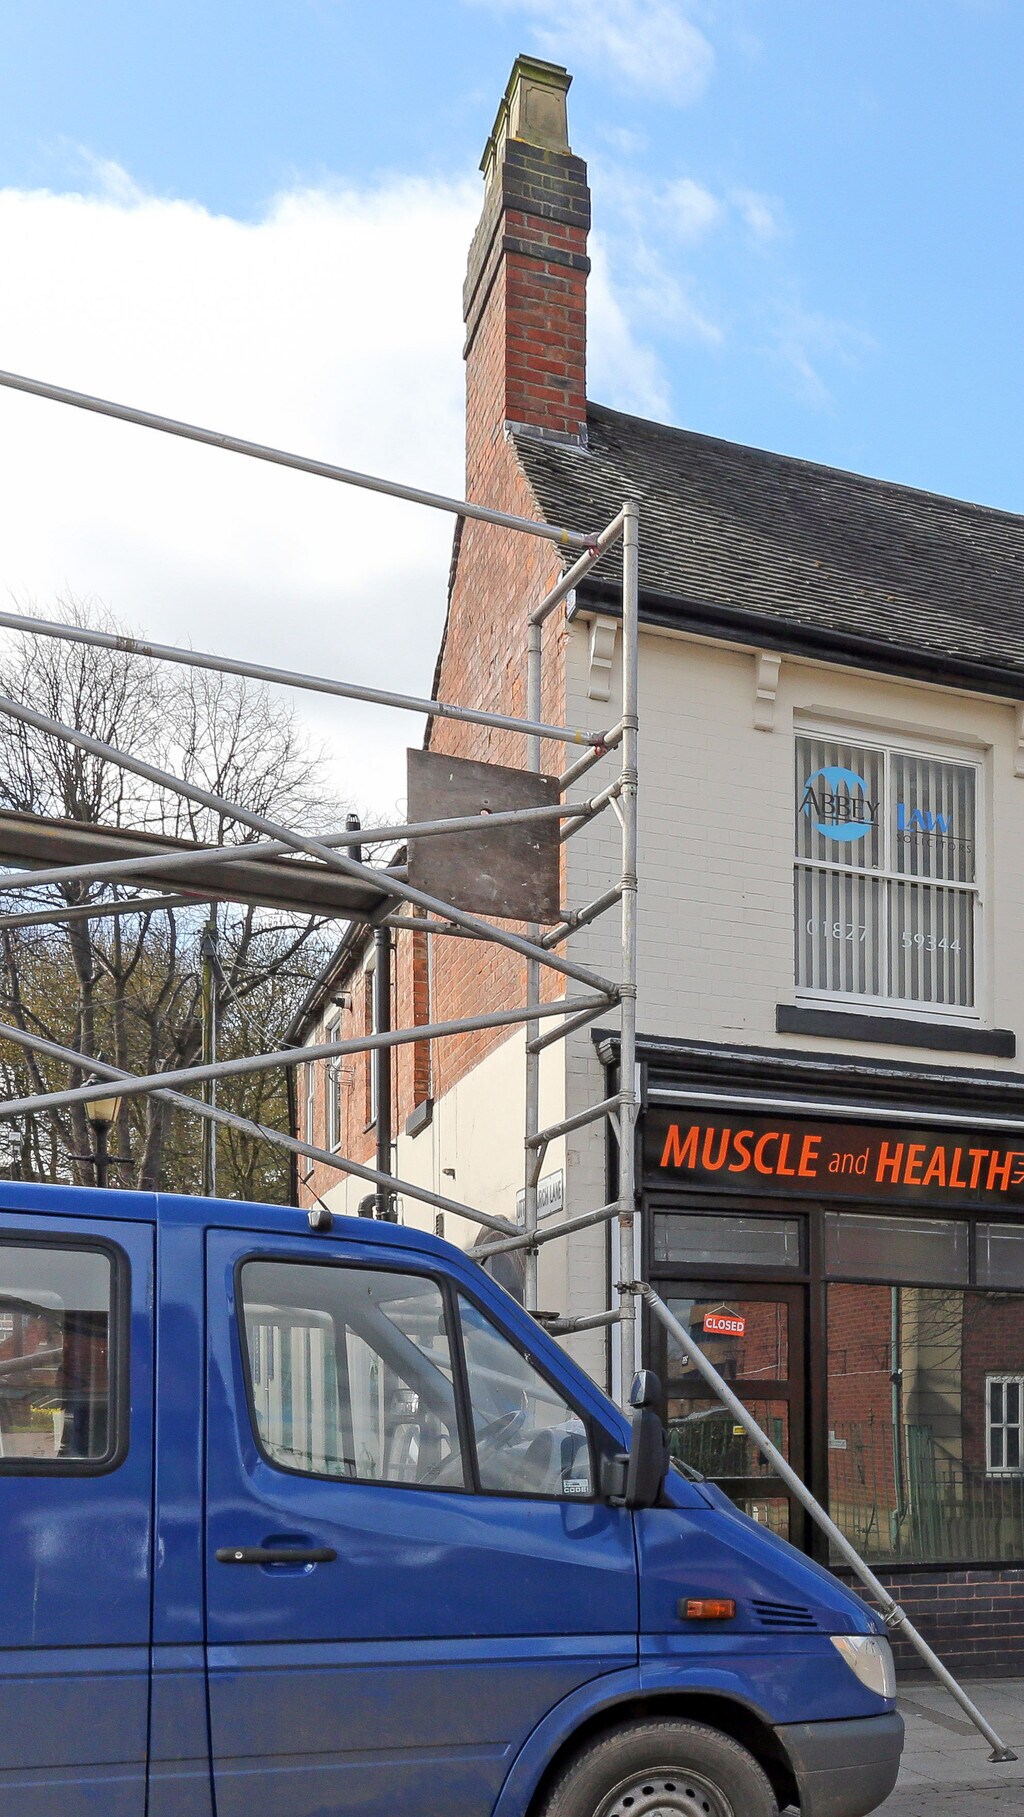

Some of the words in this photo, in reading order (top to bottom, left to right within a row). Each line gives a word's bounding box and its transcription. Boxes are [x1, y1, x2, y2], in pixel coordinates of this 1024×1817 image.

[798, 786, 880, 822] ABBEY
[895, 802, 953, 833] LAW
[896, 834, 972, 853] SOLICITORS
[806, 919, 867, 942] 01827
[901, 931, 961, 955] 59344
[660, 1123, 822, 1178] MUSCLE
[828, 1147, 869, 1176] and
[875, 1141, 1013, 1191] HEALTH
[705, 1318, 745, 1332] CLOSED
